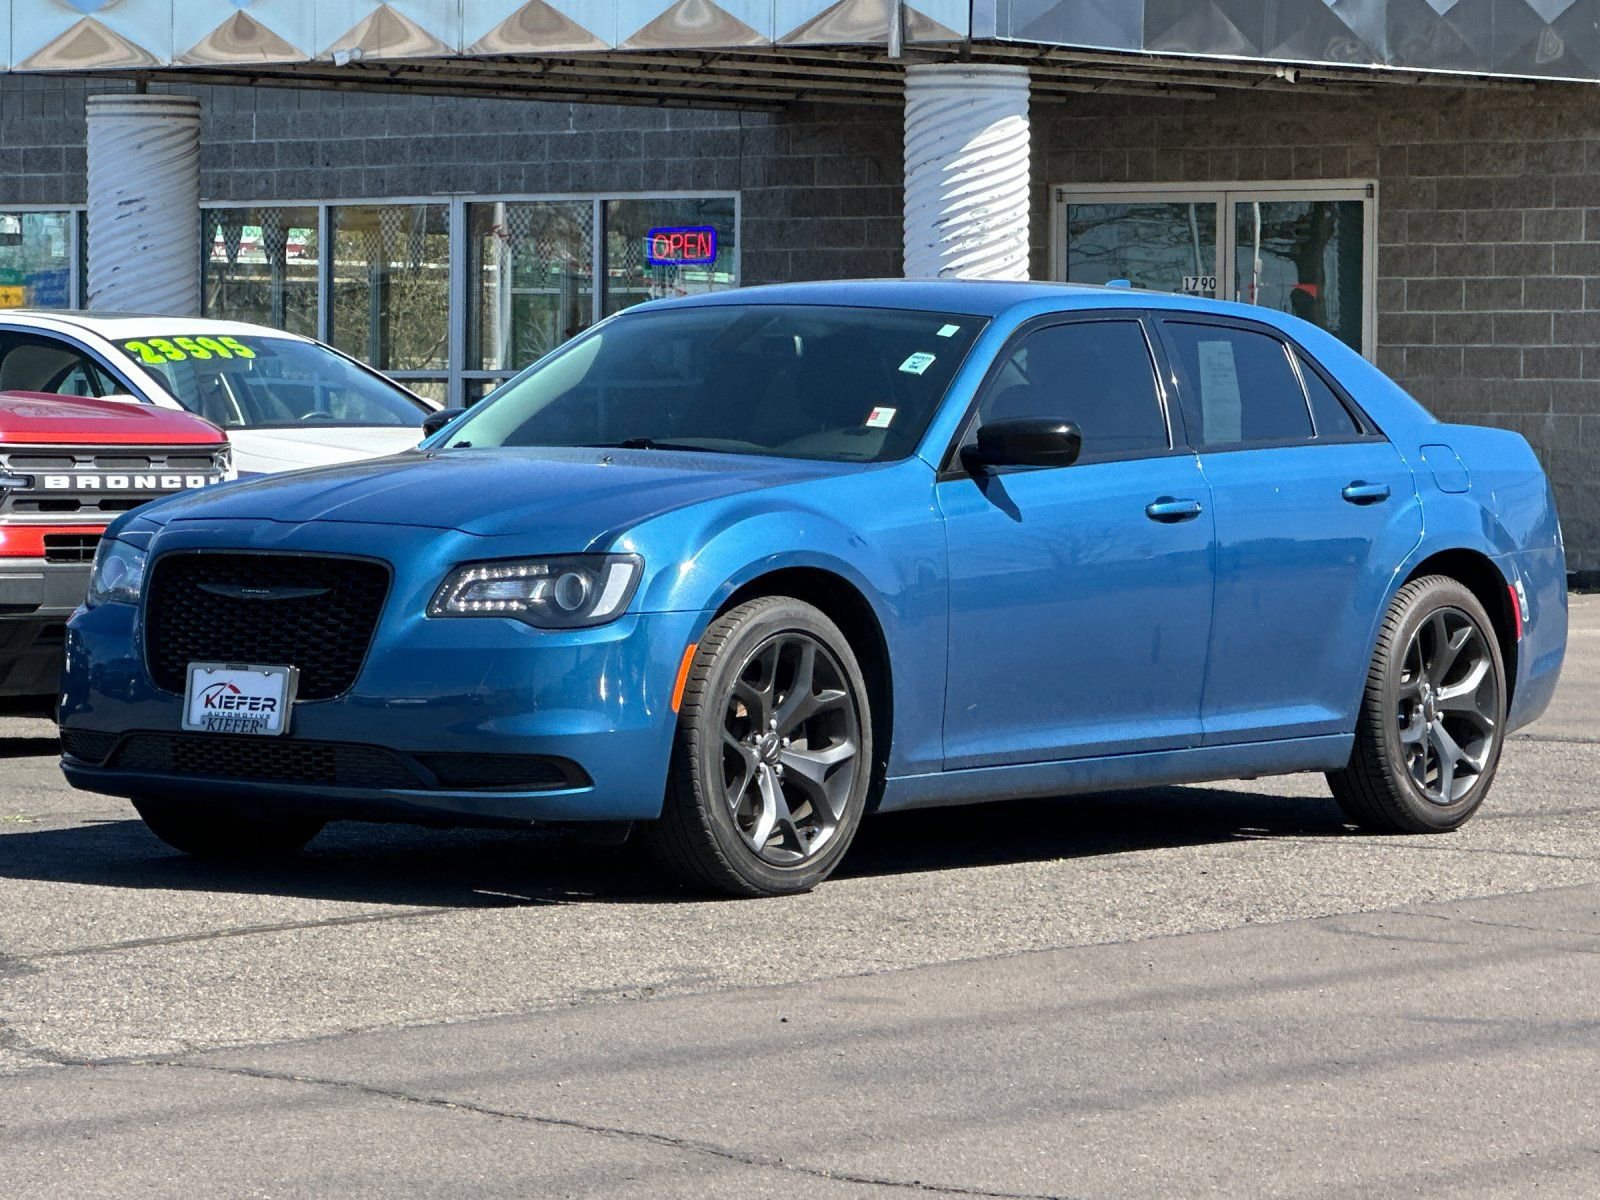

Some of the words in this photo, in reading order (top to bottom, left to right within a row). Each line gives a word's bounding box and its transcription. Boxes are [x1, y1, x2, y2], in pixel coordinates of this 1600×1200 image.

[653, 231, 712, 259] OPEN
[1185, 277, 1217, 291] 1790
[124, 336, 256, 364] 23595
[44, 475, 205, 489] BRONCO
[204, 692, 277, 712] KIEFER
[207, 711, 271, 720] AUTOMOTIVE
[205, 717, 259, 734] KIEFER
